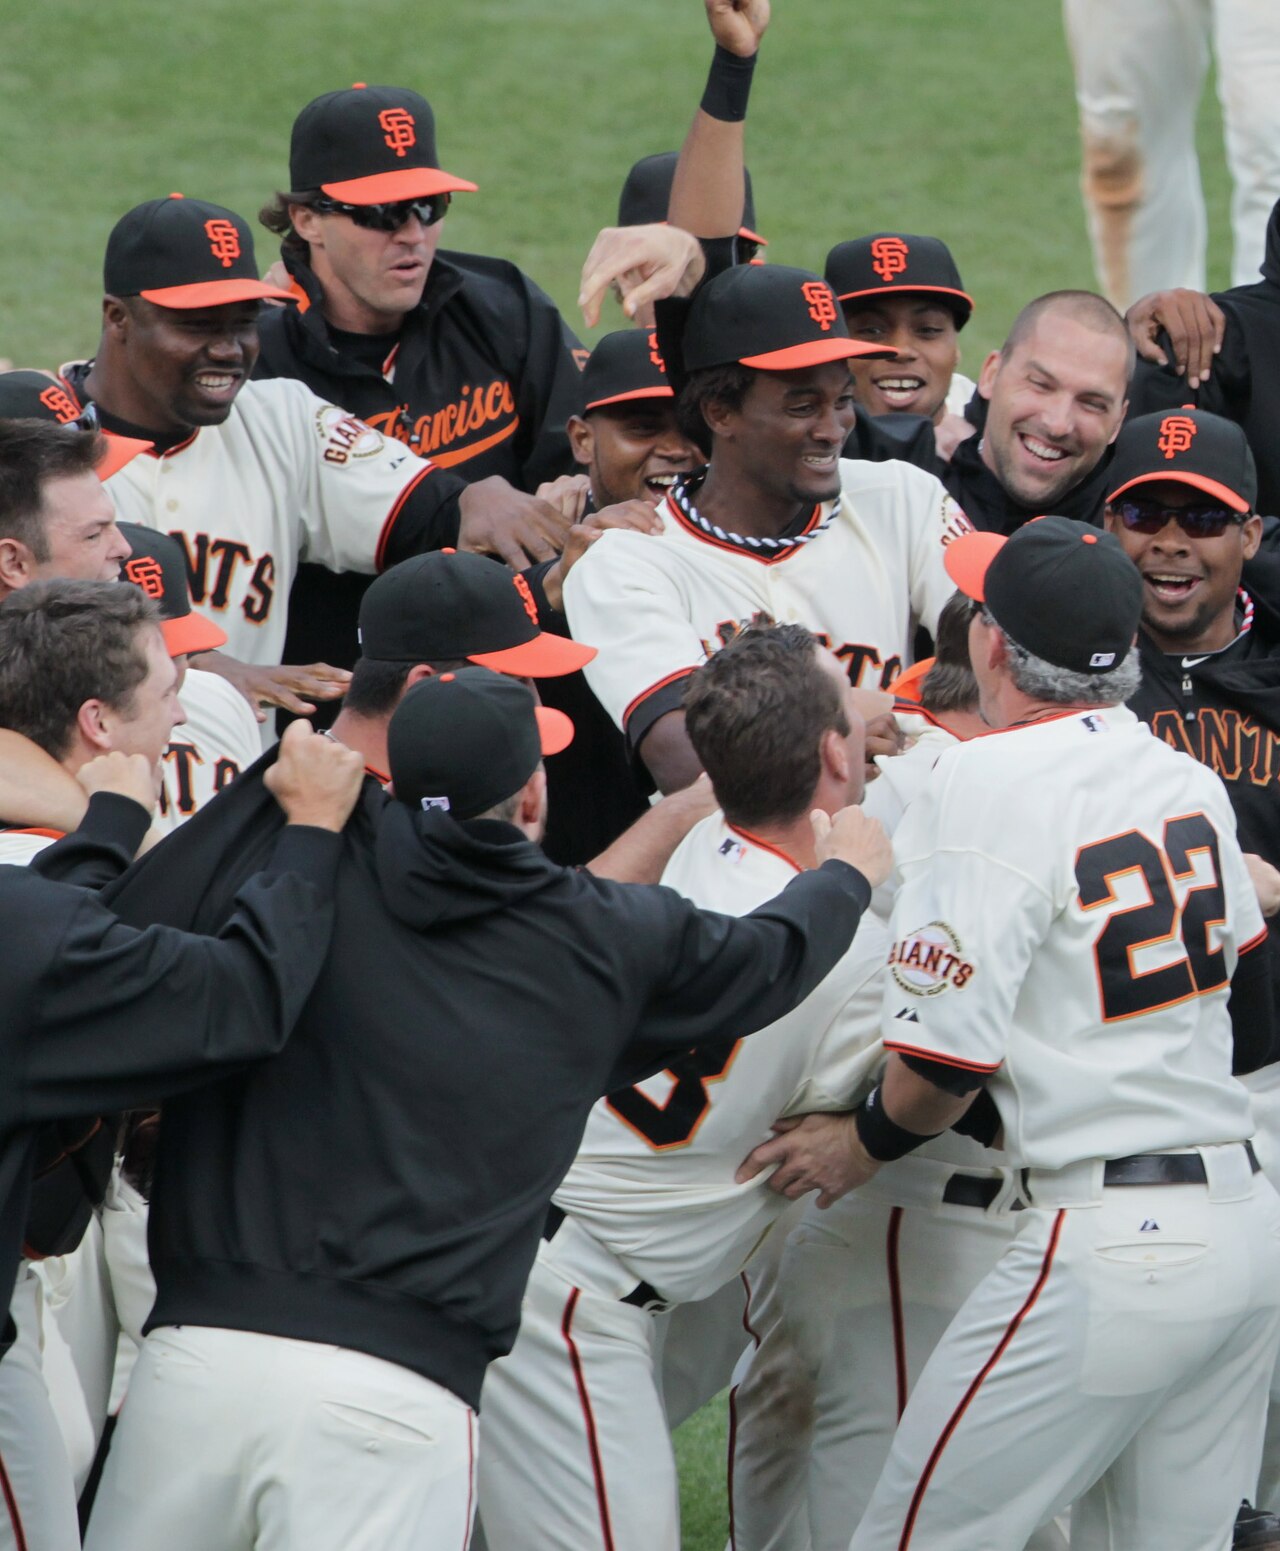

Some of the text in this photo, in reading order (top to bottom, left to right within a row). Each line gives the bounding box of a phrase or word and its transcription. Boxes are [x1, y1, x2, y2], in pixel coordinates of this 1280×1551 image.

[378, 107, 416, 157] SF
[204, 219, 241, 268] SF
[871, 236, 909, 282] SF
[801, 281, 837, 331] SF
[1158, 415, 1198, 460] SF
[1074, 809, 1232, 1025] 22
